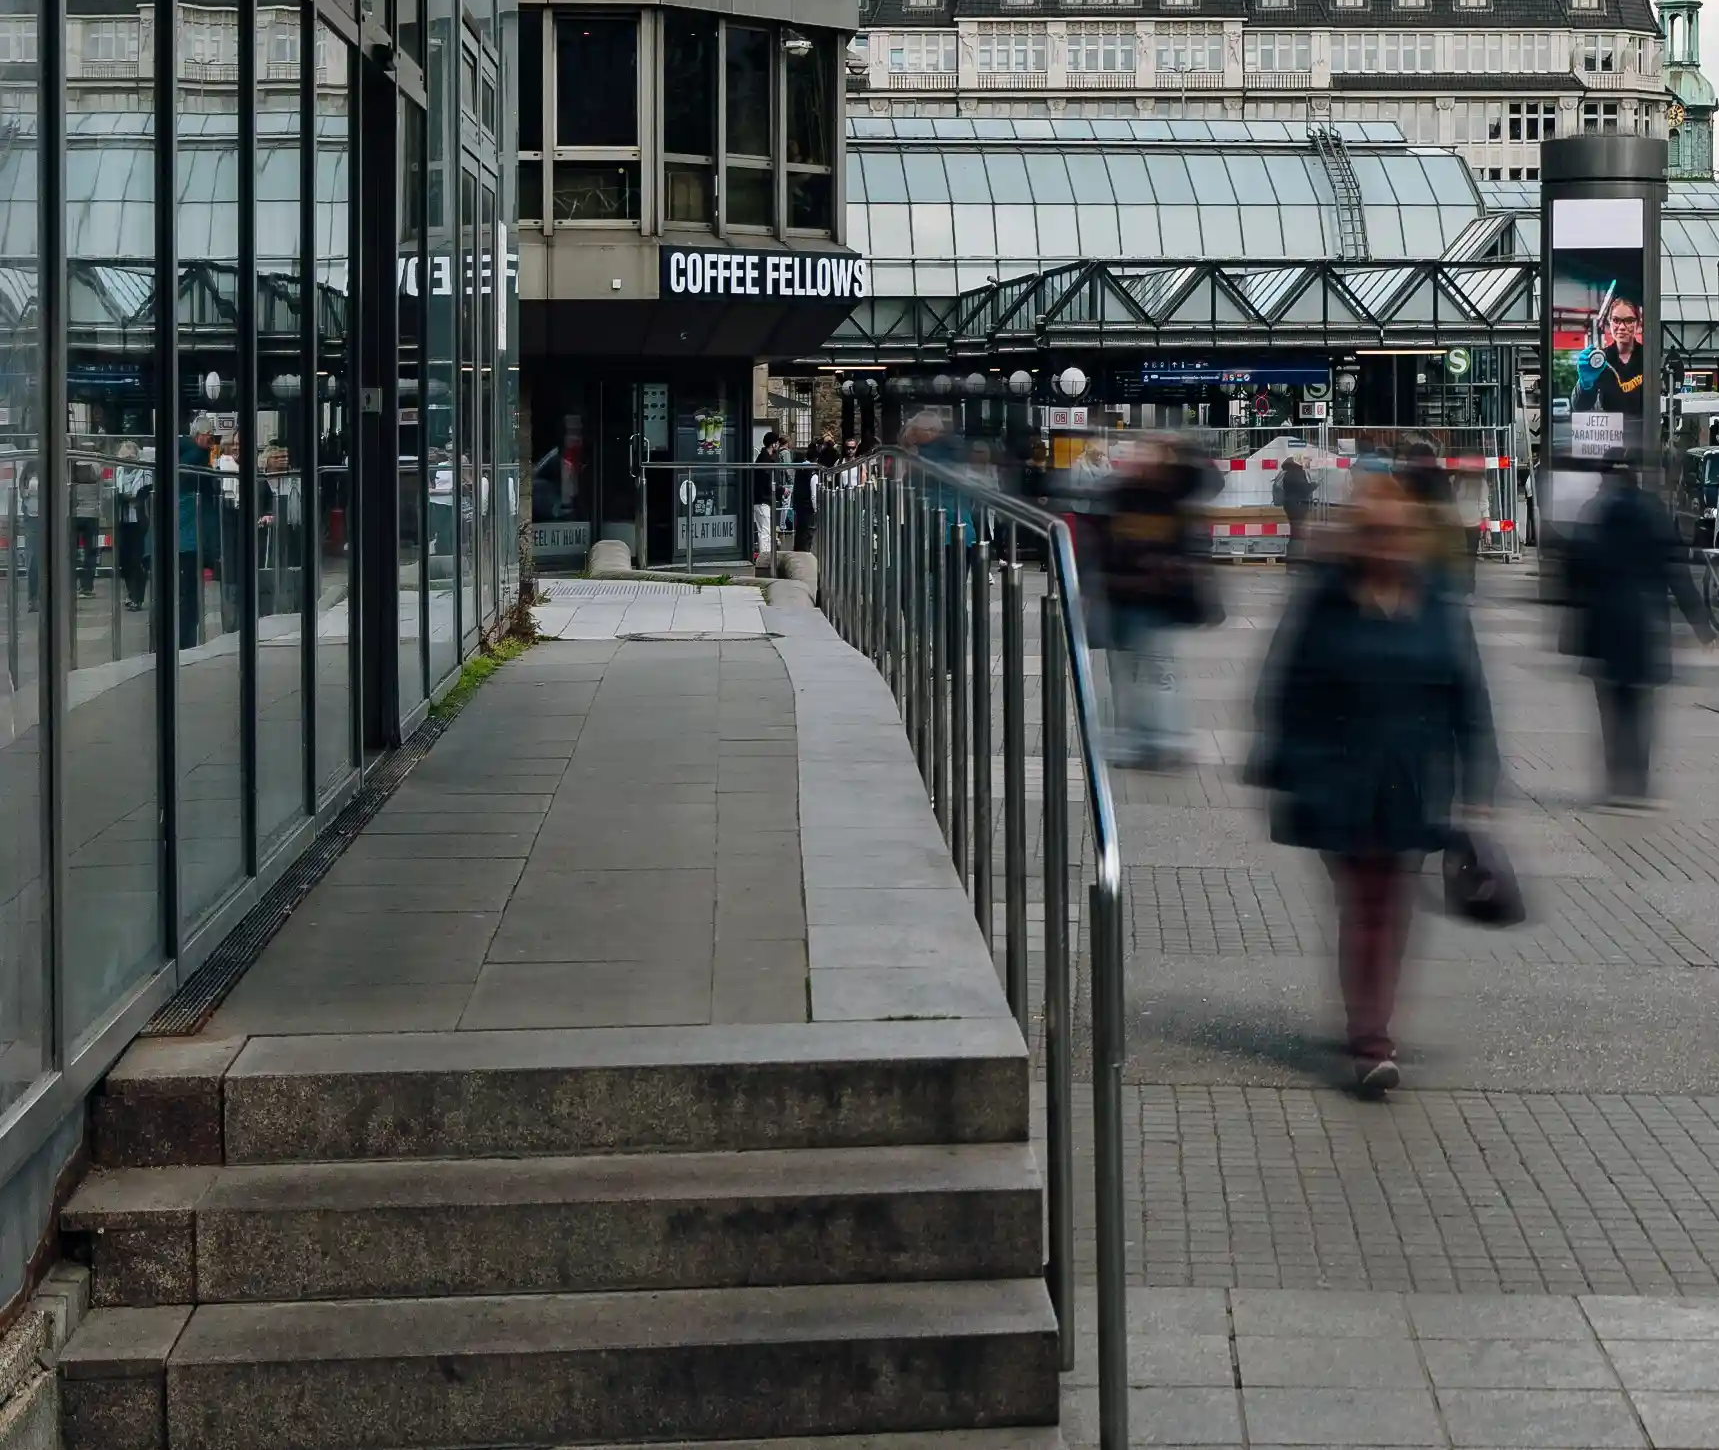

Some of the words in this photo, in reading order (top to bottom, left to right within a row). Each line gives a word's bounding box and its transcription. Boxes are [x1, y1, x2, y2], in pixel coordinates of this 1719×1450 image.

[670, 251, 760, 294] COFFEE
[766, 256, 867, 298] FELLOWS
[1586, 415, 1610, 427] JETZT
[551, 530, 560, 546] AT
[563, 528, 587, 547] HOME
[681, 521, 699, 539] FEL
[701, 522, 710, 539] AT
[711, 521, 734, 538] HOME
